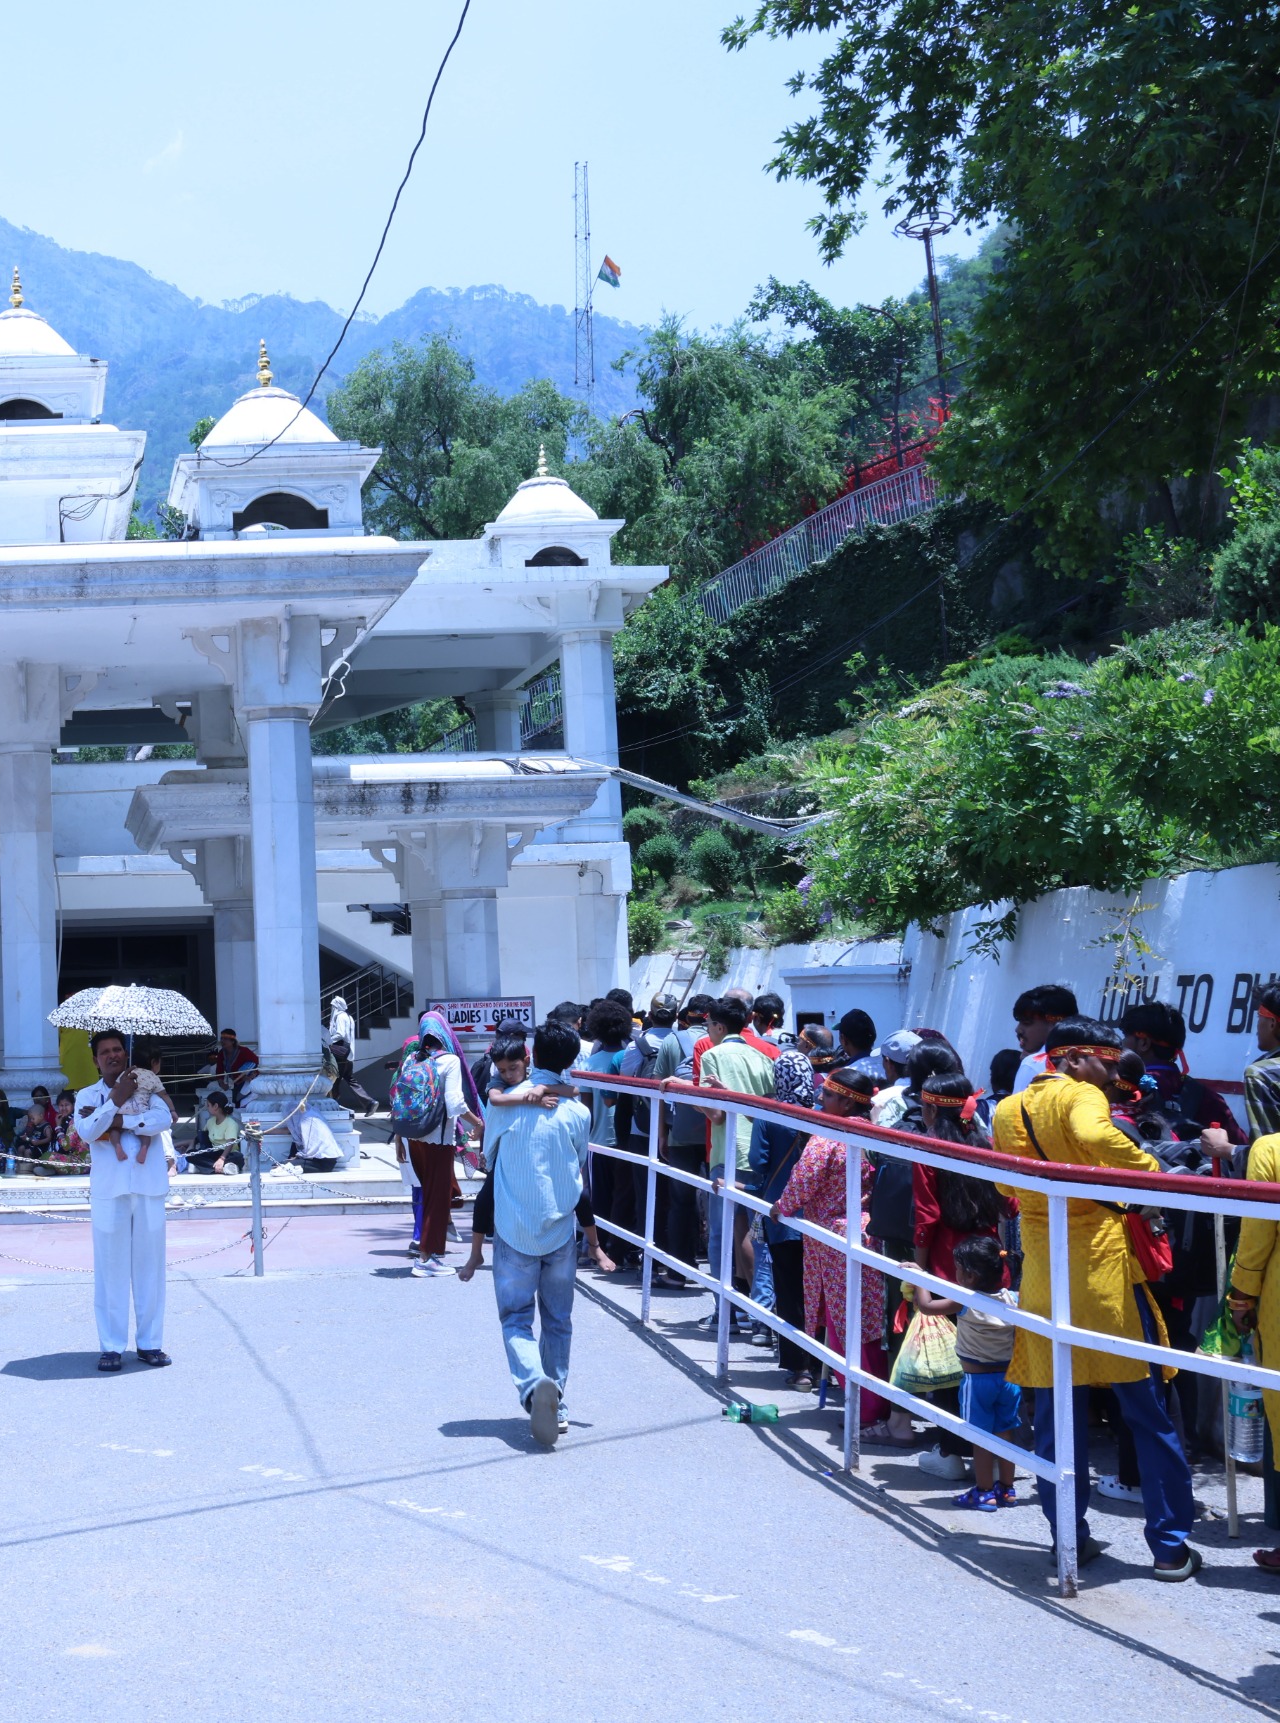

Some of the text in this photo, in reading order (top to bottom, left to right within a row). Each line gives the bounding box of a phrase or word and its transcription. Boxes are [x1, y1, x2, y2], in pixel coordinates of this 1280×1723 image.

[447, 1010, 481, 1024] LADIES
[492, 1009, 529, 1025] GENTS
[1177, 973, 1214, 1034] TO
[1226, 972, 1280, 1034] BH
